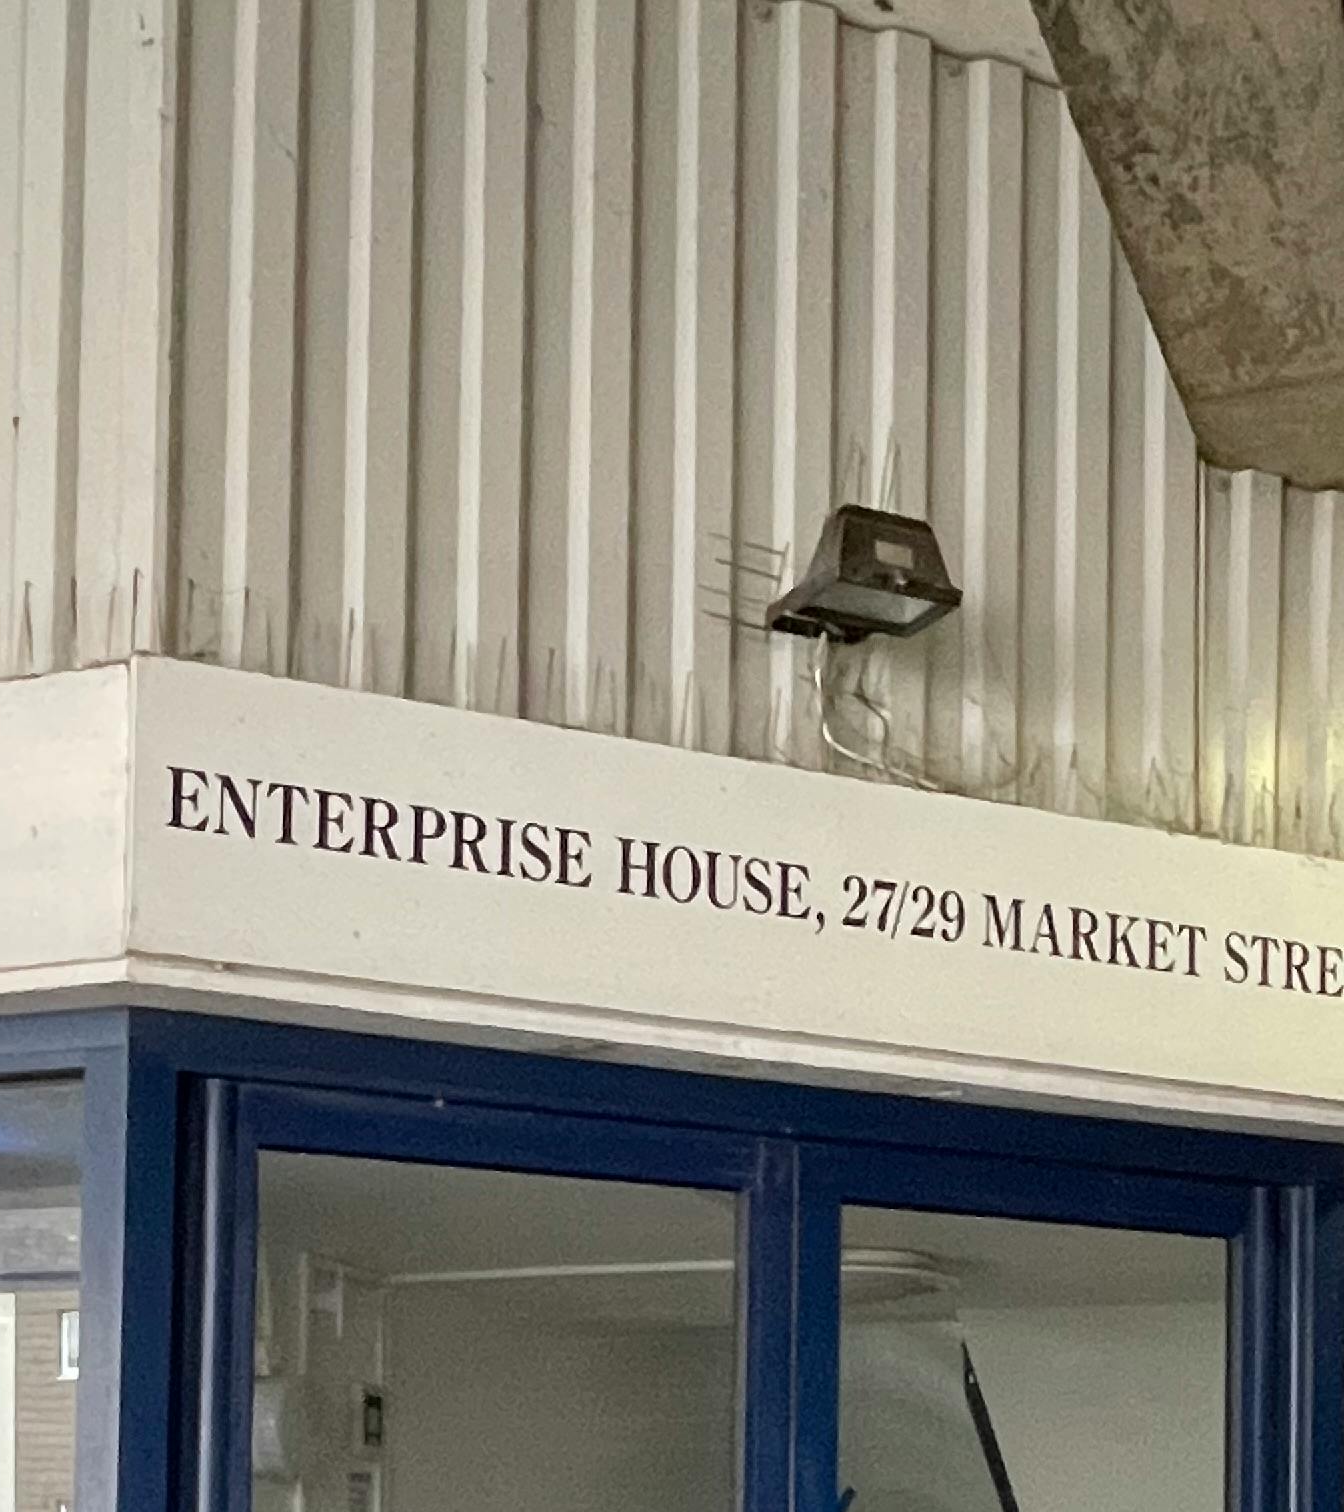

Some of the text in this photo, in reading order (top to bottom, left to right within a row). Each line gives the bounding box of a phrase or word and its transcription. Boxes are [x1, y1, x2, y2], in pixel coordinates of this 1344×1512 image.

[166, 765, 592, 888] ENTERPRISE
[614, 836, 825, 935] HOUSE,
[841, 874, 967, 943] 27/29
[982, 894, 1207, 978] MARKET
